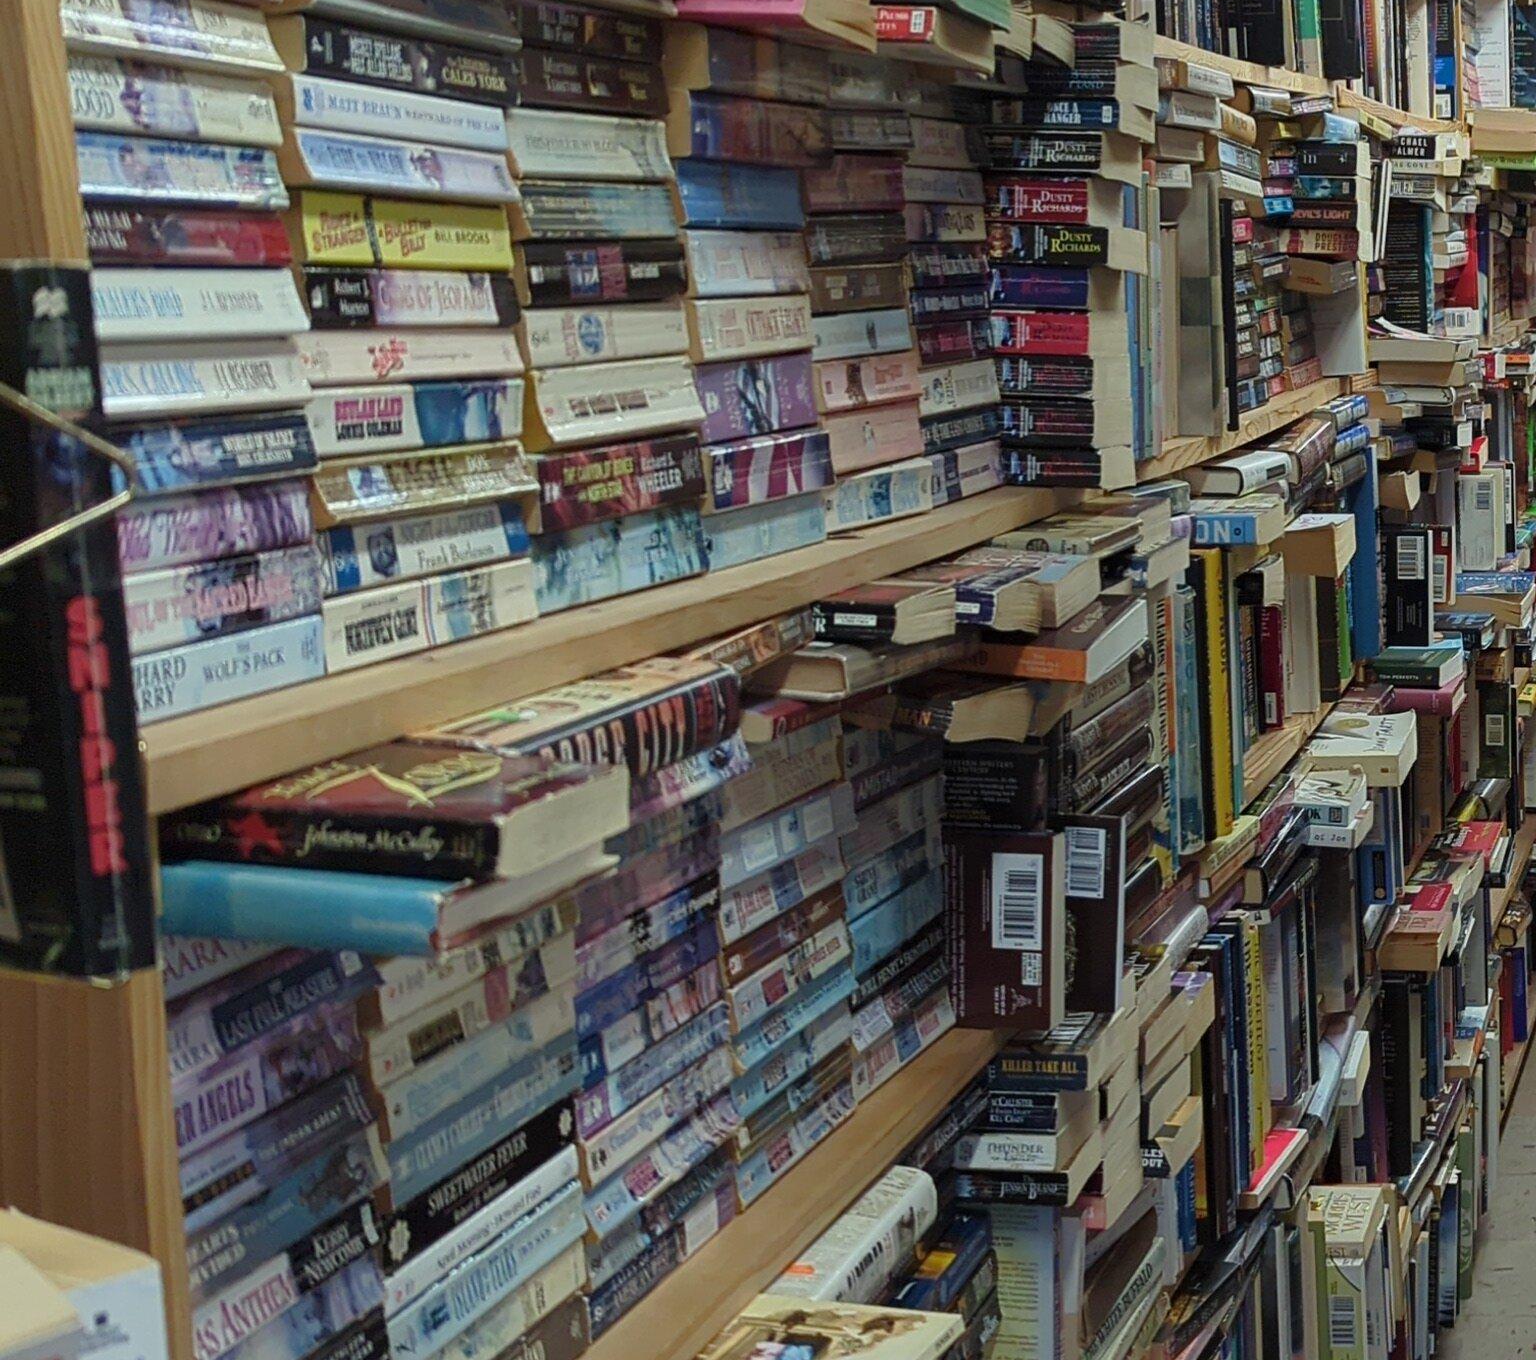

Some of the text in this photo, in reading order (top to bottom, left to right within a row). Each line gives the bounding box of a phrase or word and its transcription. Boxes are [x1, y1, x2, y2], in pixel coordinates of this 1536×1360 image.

[1055, 141, 1088, 152] DUSTY
[1045, 148, 1096, 162] RICHARDS
[1041, 191, 1074, 203] DUSTY
[1031, 199, 1083, 213] RICHARDS
[1059, 230, 1093, 242] DUSTY
[1051, 239, 1101, 253] RICHARDS
[639, 469, 683, 491] WHEELER
[203, 648, 286, 684] WOLF'S PACK
[1002, 1059, 1077, 1073] KILLER TAKE ALL
[1343, 1196, 1372, 1232] WEST
